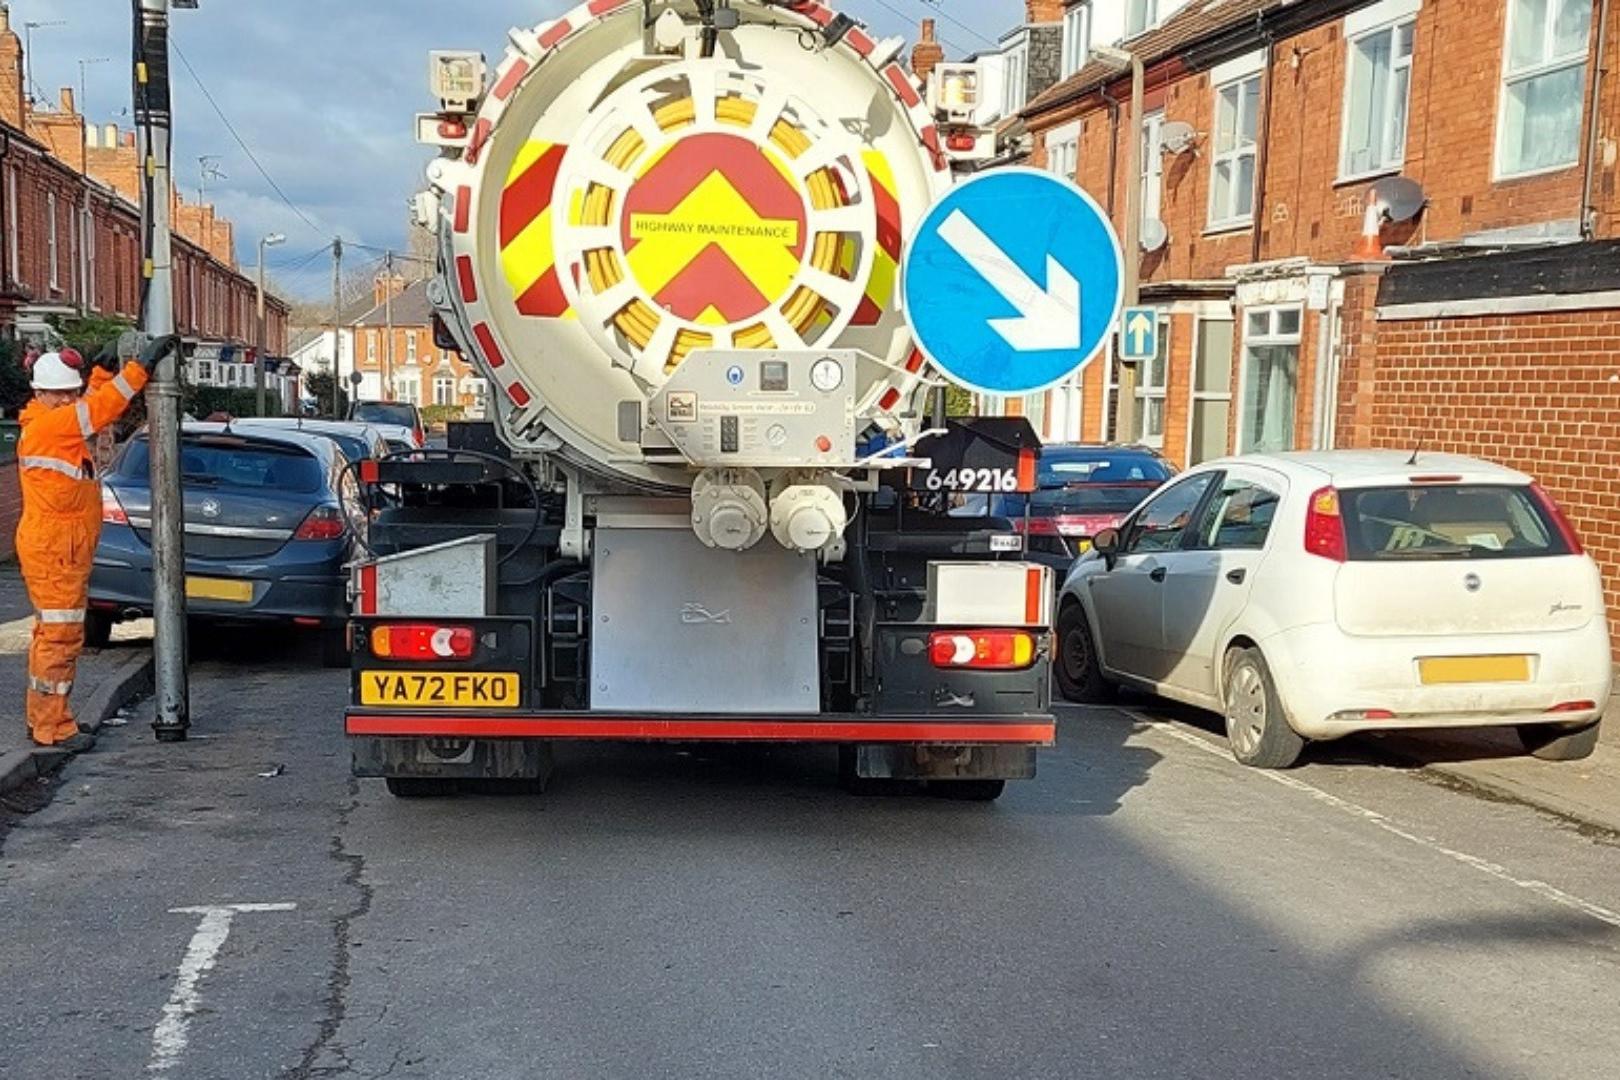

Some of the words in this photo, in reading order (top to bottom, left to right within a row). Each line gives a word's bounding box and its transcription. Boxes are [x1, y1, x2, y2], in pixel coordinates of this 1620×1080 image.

[635, 220, 694, 233] HIGHWAY
[697, 223, 790, 238] MAINTENANCE
[926, 468, 1018, 491] 649216
[374, 675, 445, 701] YA72
[453, 676, 507, 701] FKO
